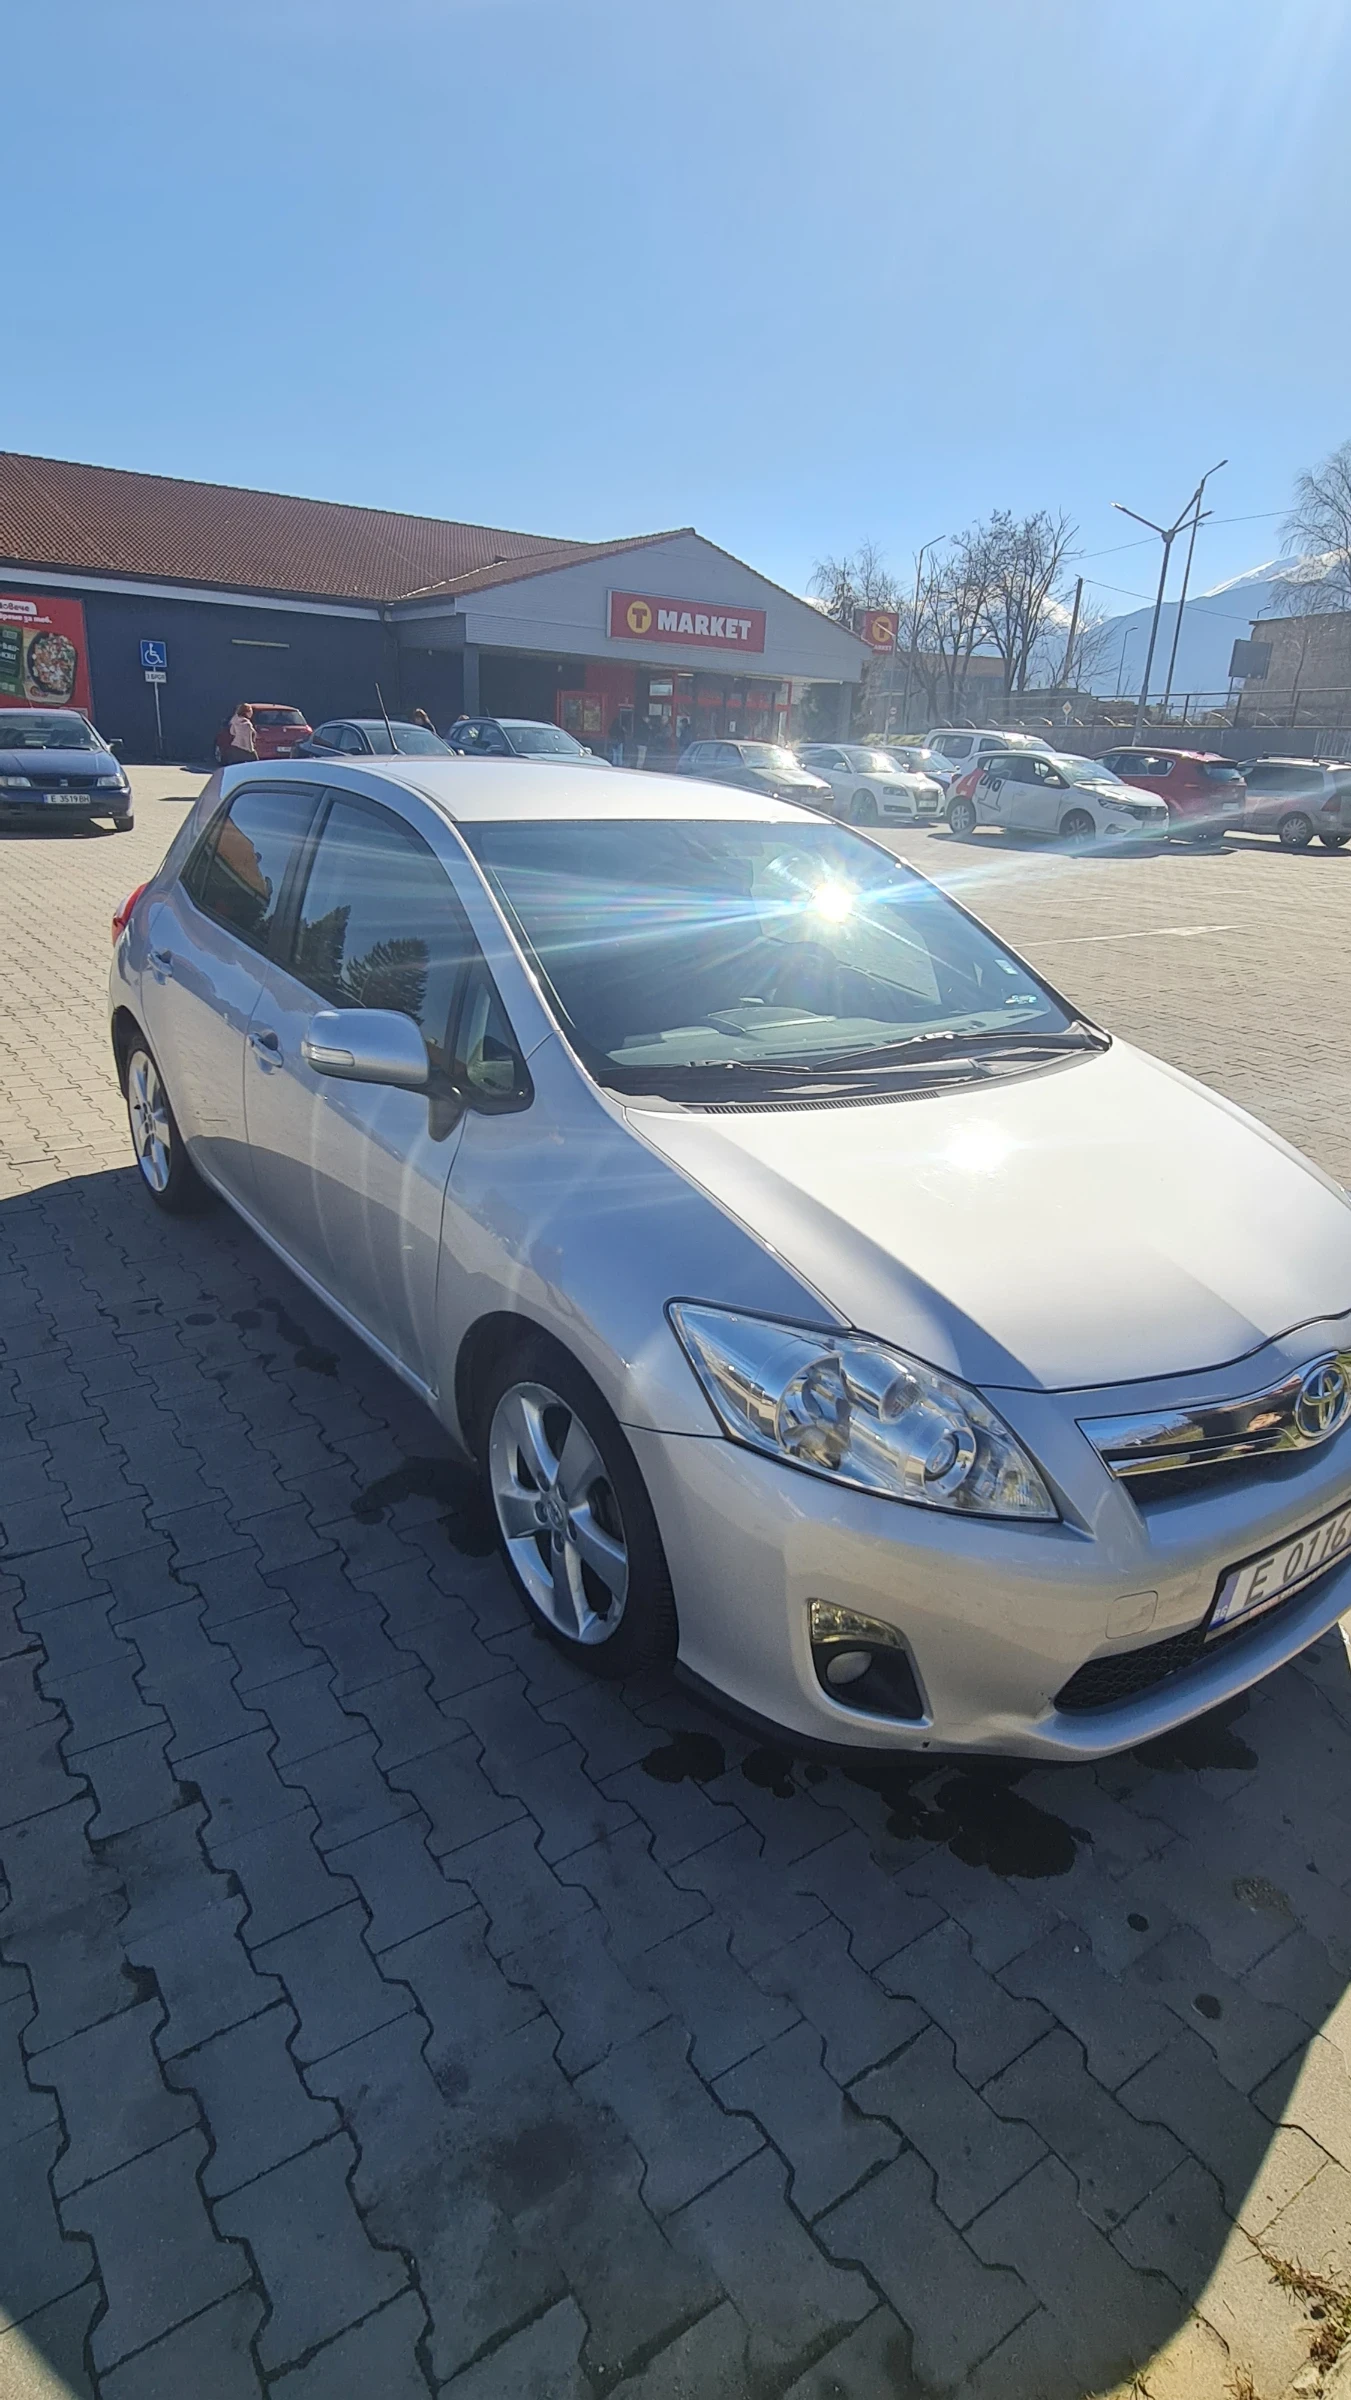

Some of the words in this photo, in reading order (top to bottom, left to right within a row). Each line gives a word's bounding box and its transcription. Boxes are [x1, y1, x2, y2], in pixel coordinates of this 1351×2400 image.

[632, 608, 647, 628] T
[657, 609, 751, 640] MARKET
[51, 795, 56, 803] E
[60, 795, 78, 803] 3519
[1244, 1557, 1275, 1607] E
[1283, 1510, 1351, 1584] 0116
[1214, 1605, 1228, 1619] BG
